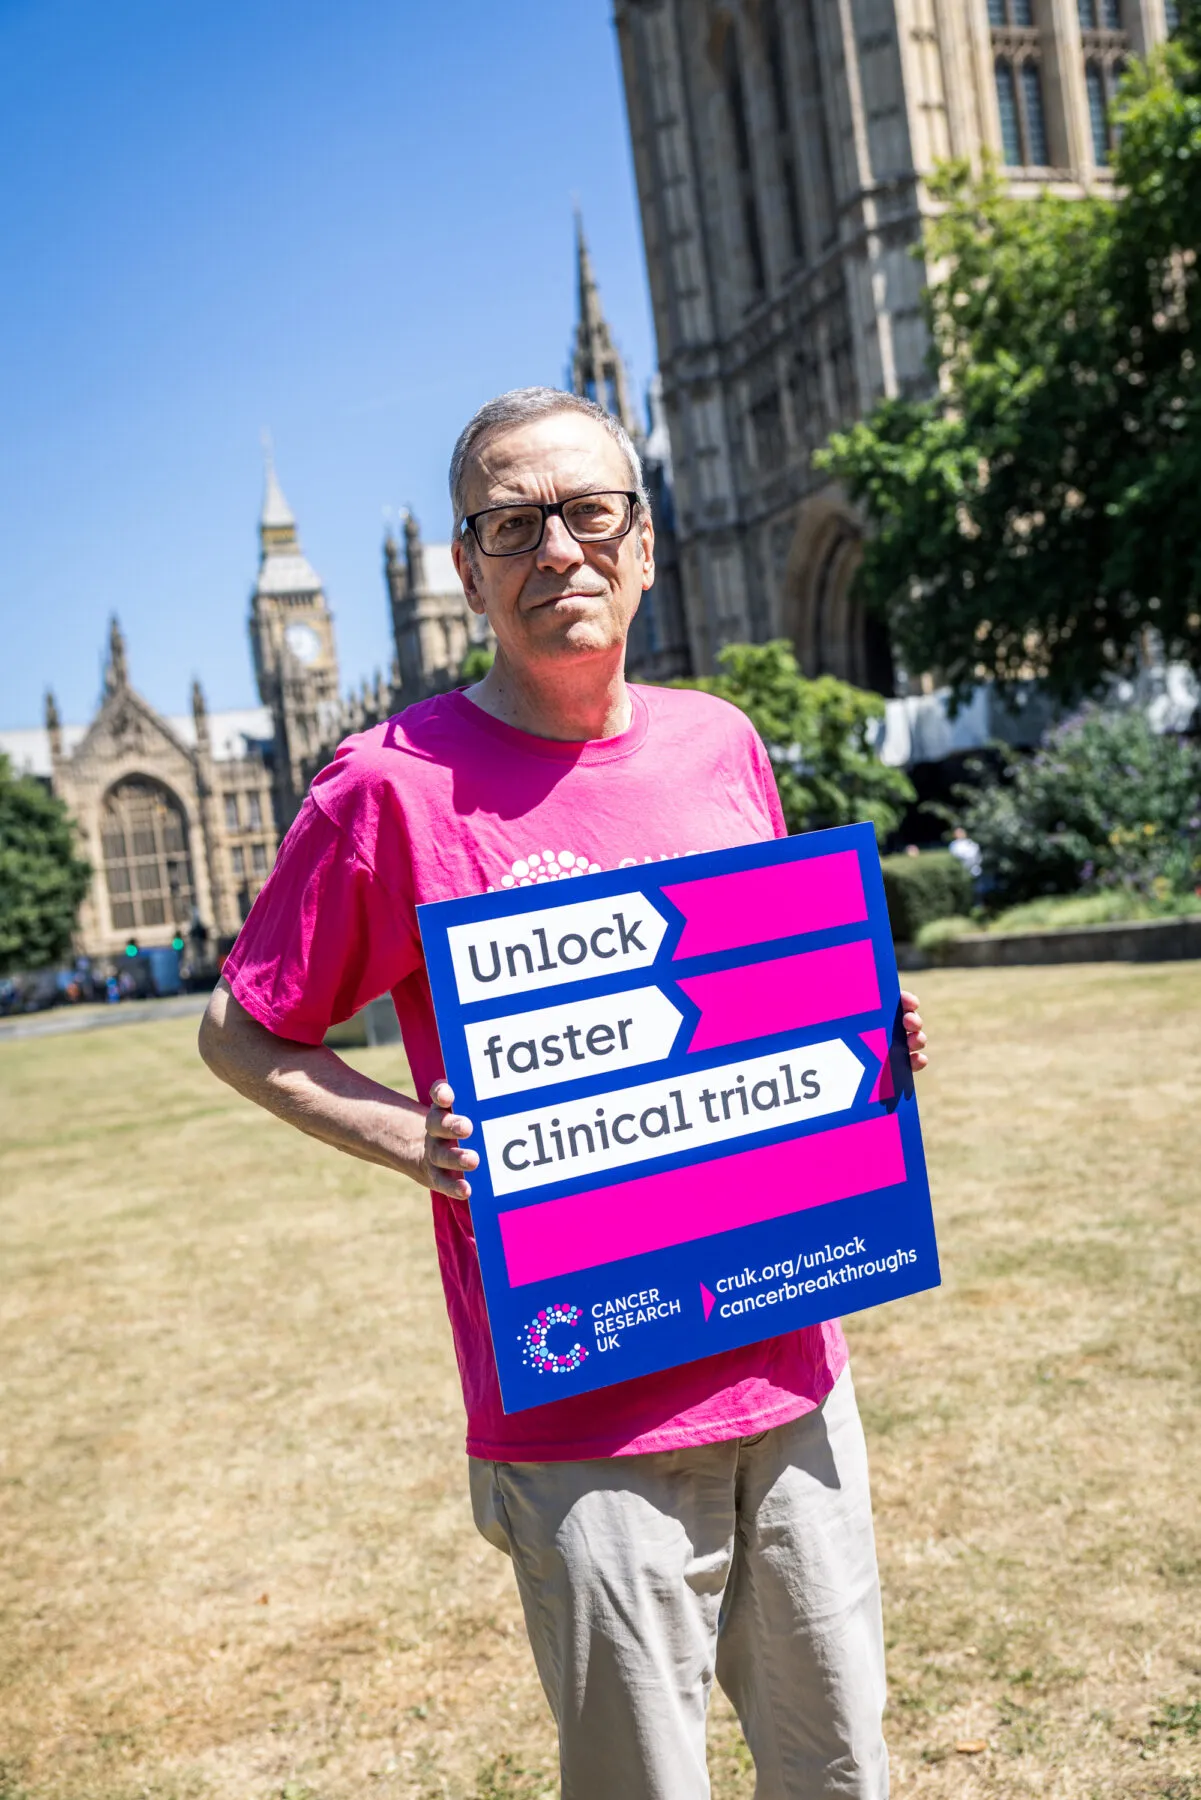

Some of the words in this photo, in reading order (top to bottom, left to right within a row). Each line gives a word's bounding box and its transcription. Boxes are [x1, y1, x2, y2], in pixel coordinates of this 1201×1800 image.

[468, 912, 647, 983] Unlock
[483, 1017, 633, 1079] faster
[502, 1090, 693, 1172] clinical
[699, 1064, 821, 1123] trials
[715, 1236, 867, 1294] cruk.org/unlock
[719, 1247, 918, 1319] cancerbreakthroughs
[591, 1288, 661, 1319] CANCER
[594, 1300, 682, 1336] RESEARCH
[596, 1334, 621, 1353] UK
